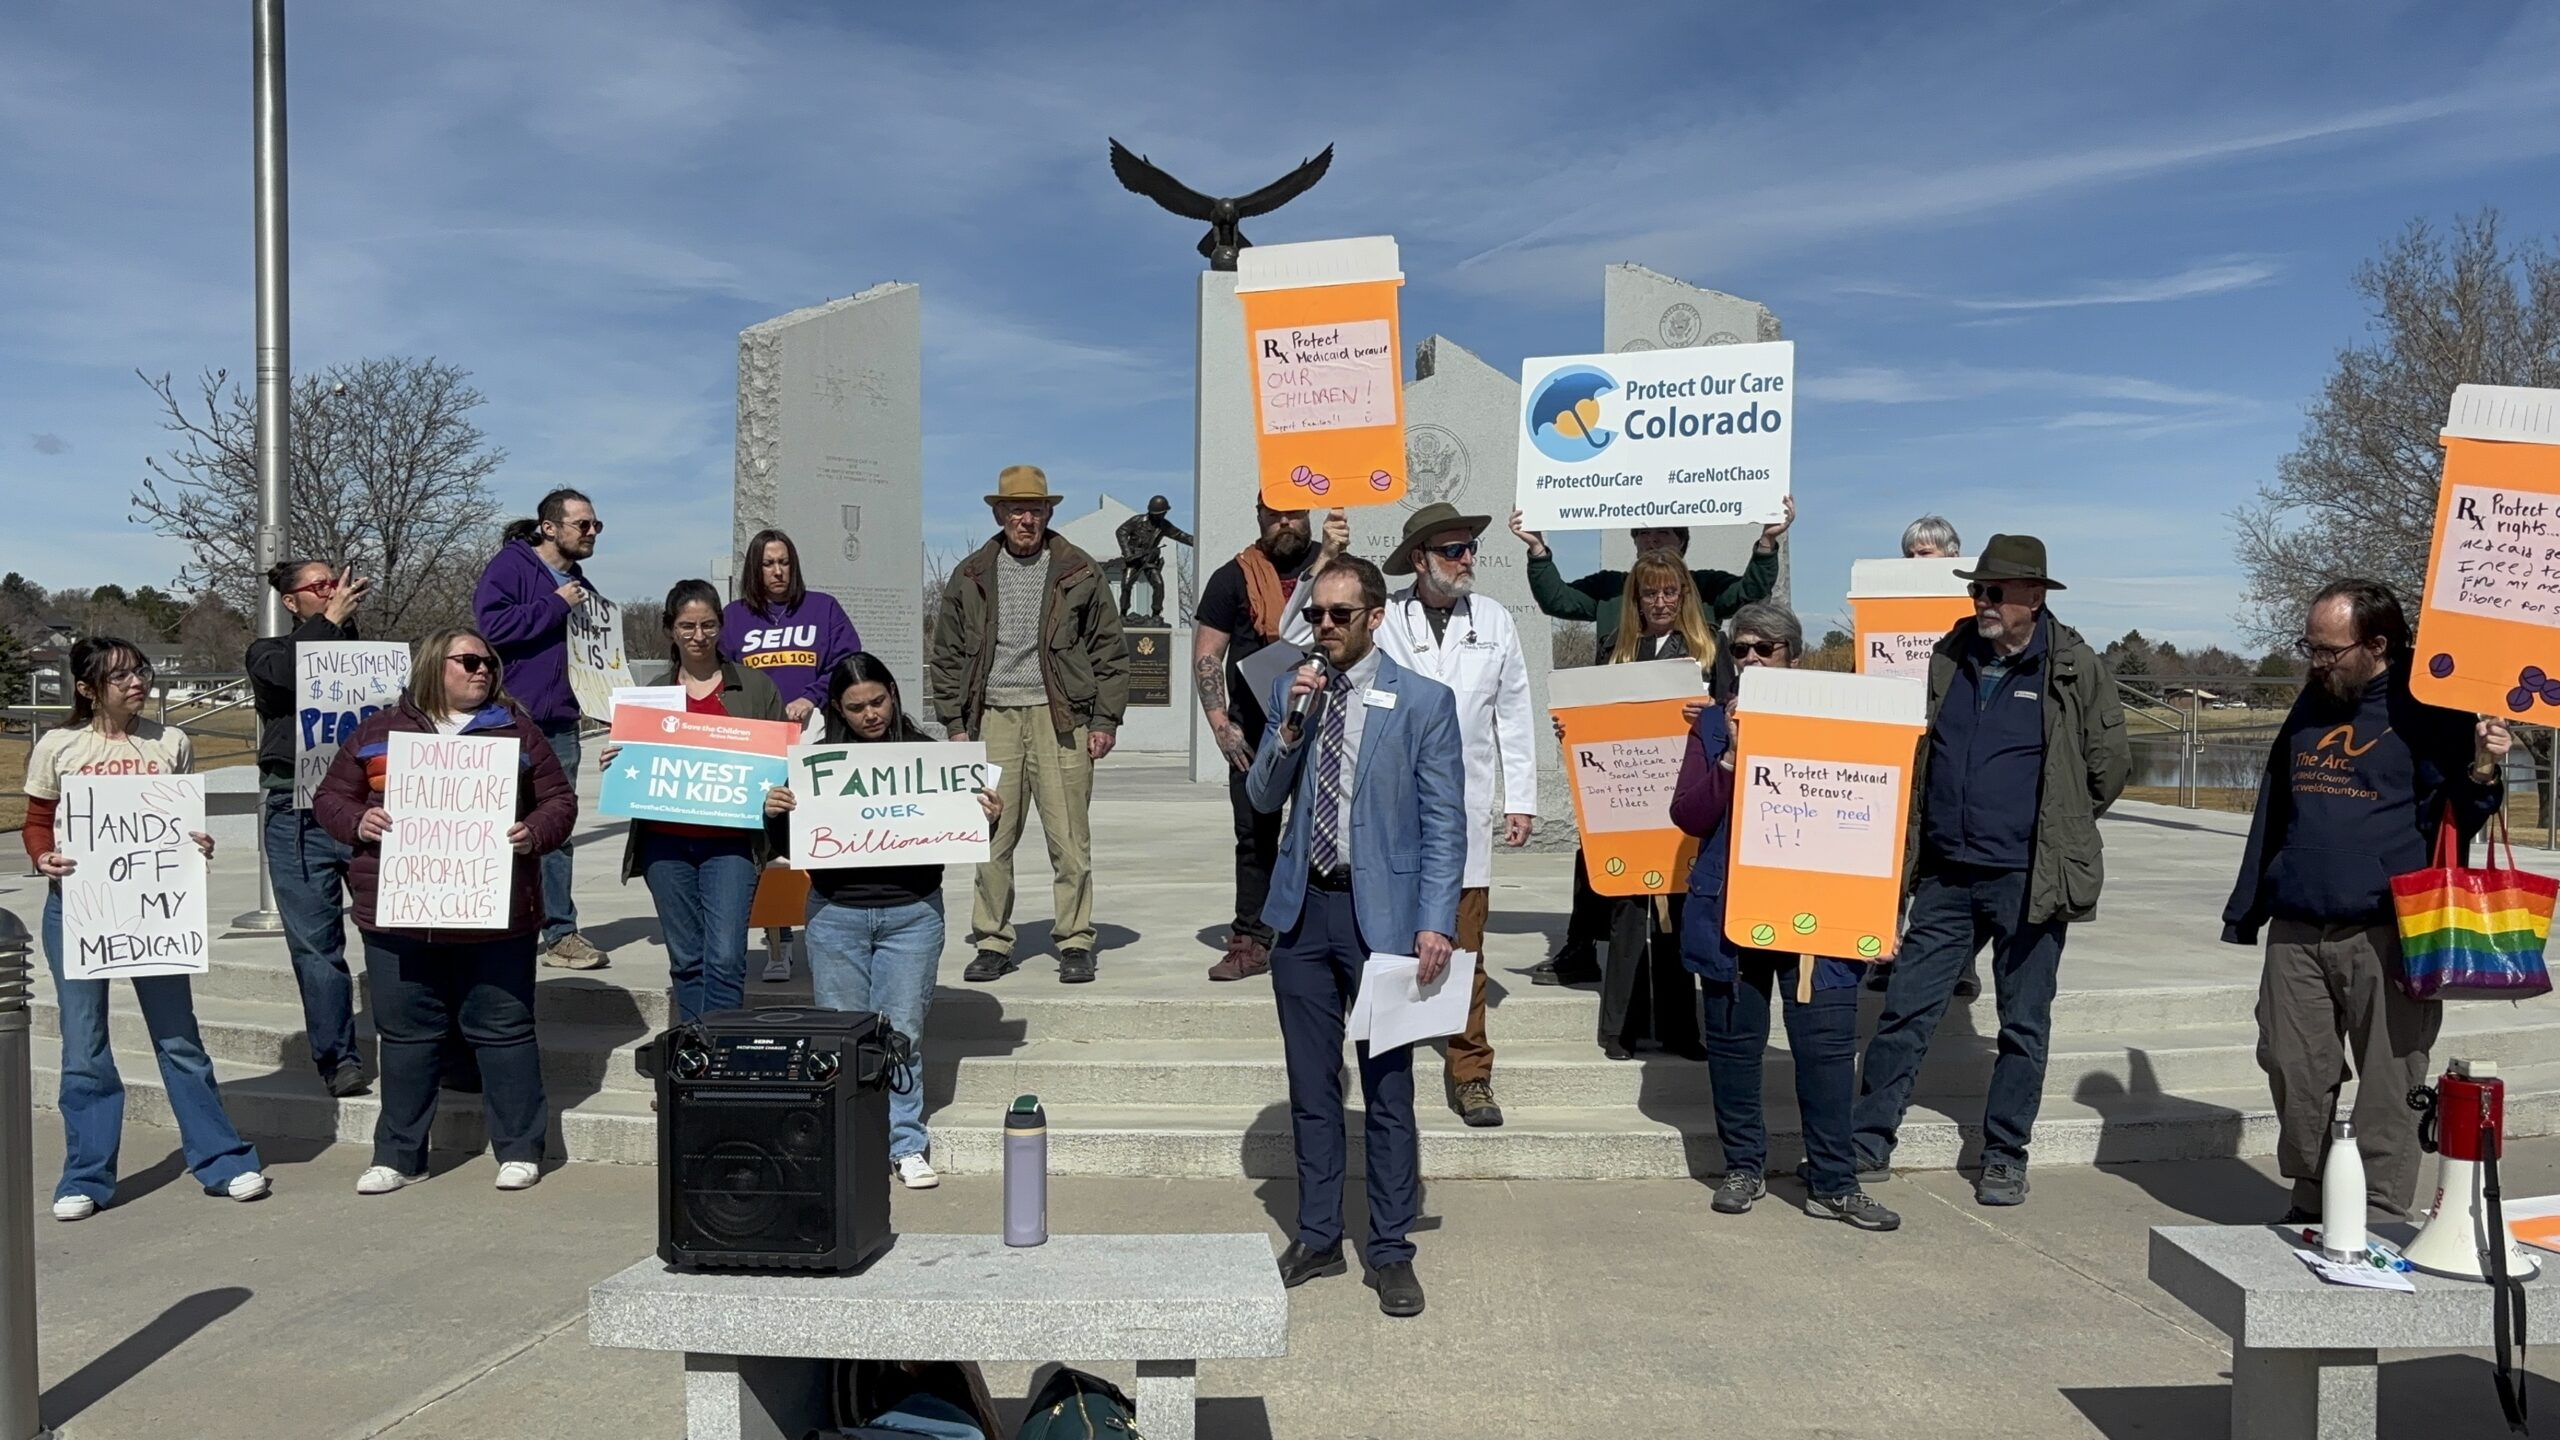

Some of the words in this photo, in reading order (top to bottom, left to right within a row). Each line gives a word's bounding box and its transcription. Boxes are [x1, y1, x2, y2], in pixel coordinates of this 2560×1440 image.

[1292, 329, 1340, 349] Protect
[1296, 347, 1350, 363] Medicaid
[1267, 368, 1312, 389] OUR
[1626, 377, 1696, 401] Protect
[1700, 375, 1736, 396] Our
[1740, 373, 1784, 394] Care
[1624, 401, 1782, 440] Colorado
[1536, 472, 1643, 490] #ProtectOurCare
[1668, 465, 1770, 484] #CareNotChaos
[1559, 499, 1743, 520] www.ProtectOurCareCO.org
[2492, 493, 2548, 516] Protect
[1367, 536, 1398, 548] WEL
[581, 591, 610, 624] HIS
[741, 625, 817, 652] SEIU
[1896, 634, 1934, 648] Protect
[303, 650, 408, 680] INVESTMENTS
[587, 644, 604, 670] IS
[744, 653, 786, 667] LOCAL
[790, 653, 815, 664] 105
[347, 686, 366, 705] IN
[682, 721, 701, 732] Save
[702, 724, 716, 733] the
[717, 726, 751, 737] Children
[1612, 743, 1659, 756] Protect
[81, 759, 160, 775] PEOPLE
[651, 756, 753, 785] INVEST
[1613, 757, 1666, 769] Medicare
[2296, 752, 2319, 767] The
[2320, 753, 2350, 770] Arc
[802, 751, 987, 797] FAMILIES
[1608, 770, 1639, 780] Social
[1784, 763, 1829, 781] Protect
[1836, 769, 1888, 785] Medicaid
[2316, 772, 2351, 784] County
[388, 773, 512, 813] HEALTHCARE
[648, 777, 679, 799] IN
[686, 781, 748, 805] KIDS
[1618, 784, 1655, 798] forget
[630, 802, 760, 821] SavetheChildrenActionNetwork.org
[861, 804, 925, 820] OVER
[1610, 798, 1649, 808] Elders
[1760, 801, 1818, 823] people
[1836, 804, 1871, 821] need
[66, 787, 182, 851] HANDS
[808, 826, 987, 858] Billionaires
[109, 850, 179, 882] OFF
[383, 855, 499, 889] CORPORATE
[141, 891, 186, 919] MY
[389, 890, 433, 922] TAX
[440, 889, 494, 919] CUTS
[80, 931, 203, 966] MEDICAID
[2431, 1187, 2444, 1220] PYLE
